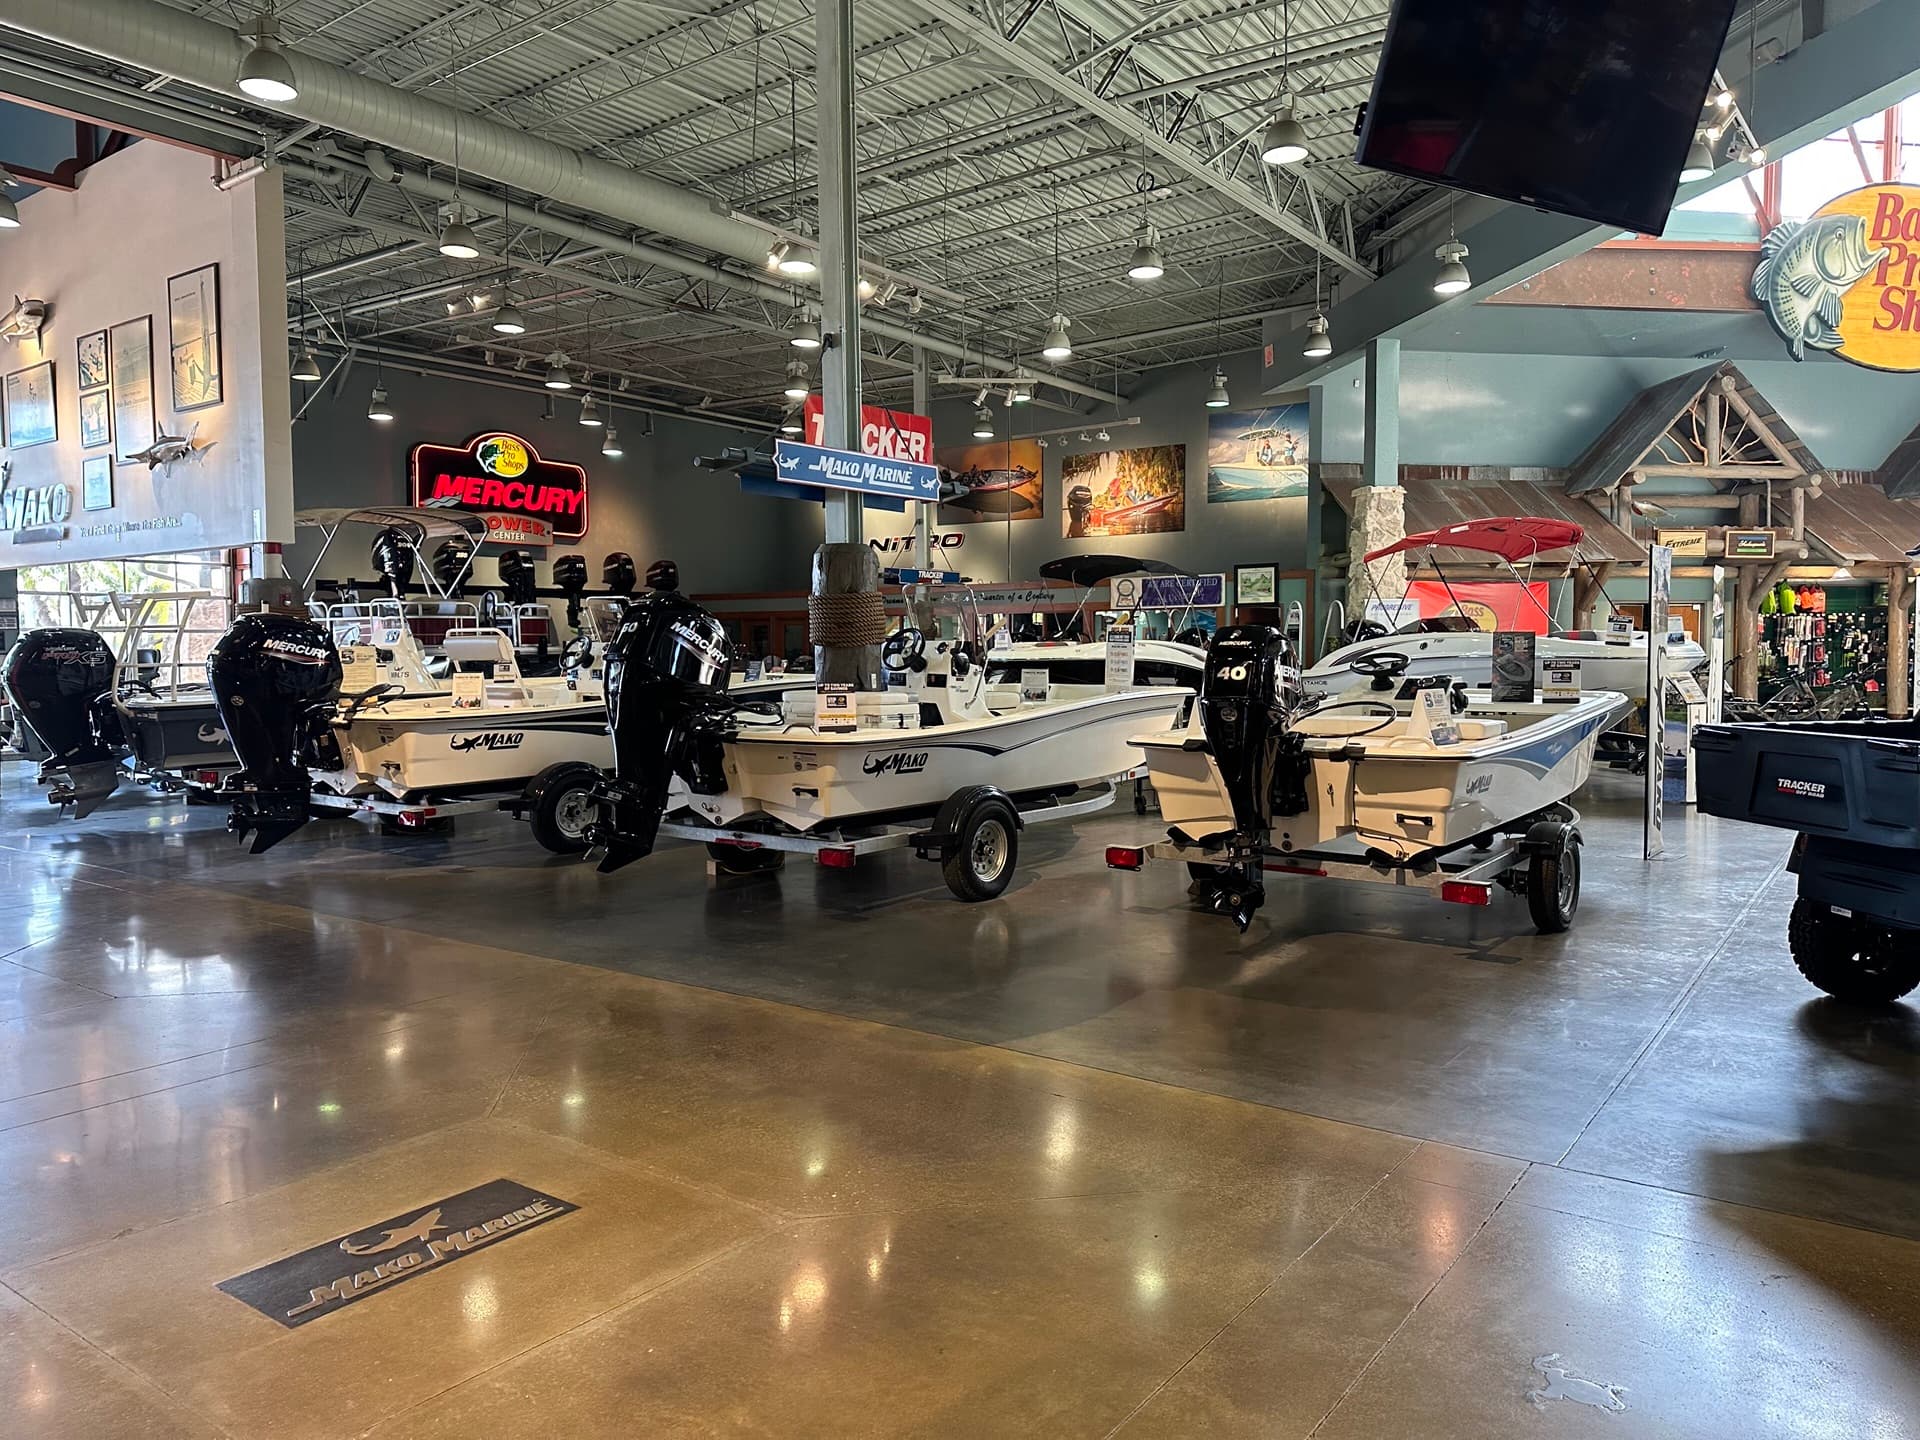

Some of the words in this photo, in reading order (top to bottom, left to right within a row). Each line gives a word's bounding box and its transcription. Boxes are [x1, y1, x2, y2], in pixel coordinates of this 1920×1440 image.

[1873, 242, 1920, 287] Pr
[501, 439, 520, 451] Bass
[812, 412, 926, 462] TCKER
[502, 450, 516, 459] Pro
[503, 458, 526, 471] Shops
[809, 455, 861, 483] MAKO
[861, 462, 915, 490] MARINE
[432, 473, 585, 514] MERCURY
[0, 482, 68, 532] MAKO
[153, 517, 165, 529] Fish
[486, 515, 546, 537] OWER
[493, 531, 526, 541] CENTER
[918, 570, 944, 579] TRACKER
[1176, 577, 1218, 587] CERTFIED
[262, 638, 331, 660] MERCURY
[669, 621, 729, 664] MERCURY
[1217, 666, 1247, 681] 40
[477, 732, 524, 751] MAKO
[885, 752, 929, 774] MAKO
[1777, 778, 1826, 793] TRACKER
[287, 1253, 424, 1317] MAKO
[427, 1199, 564, 1263] MARINE
